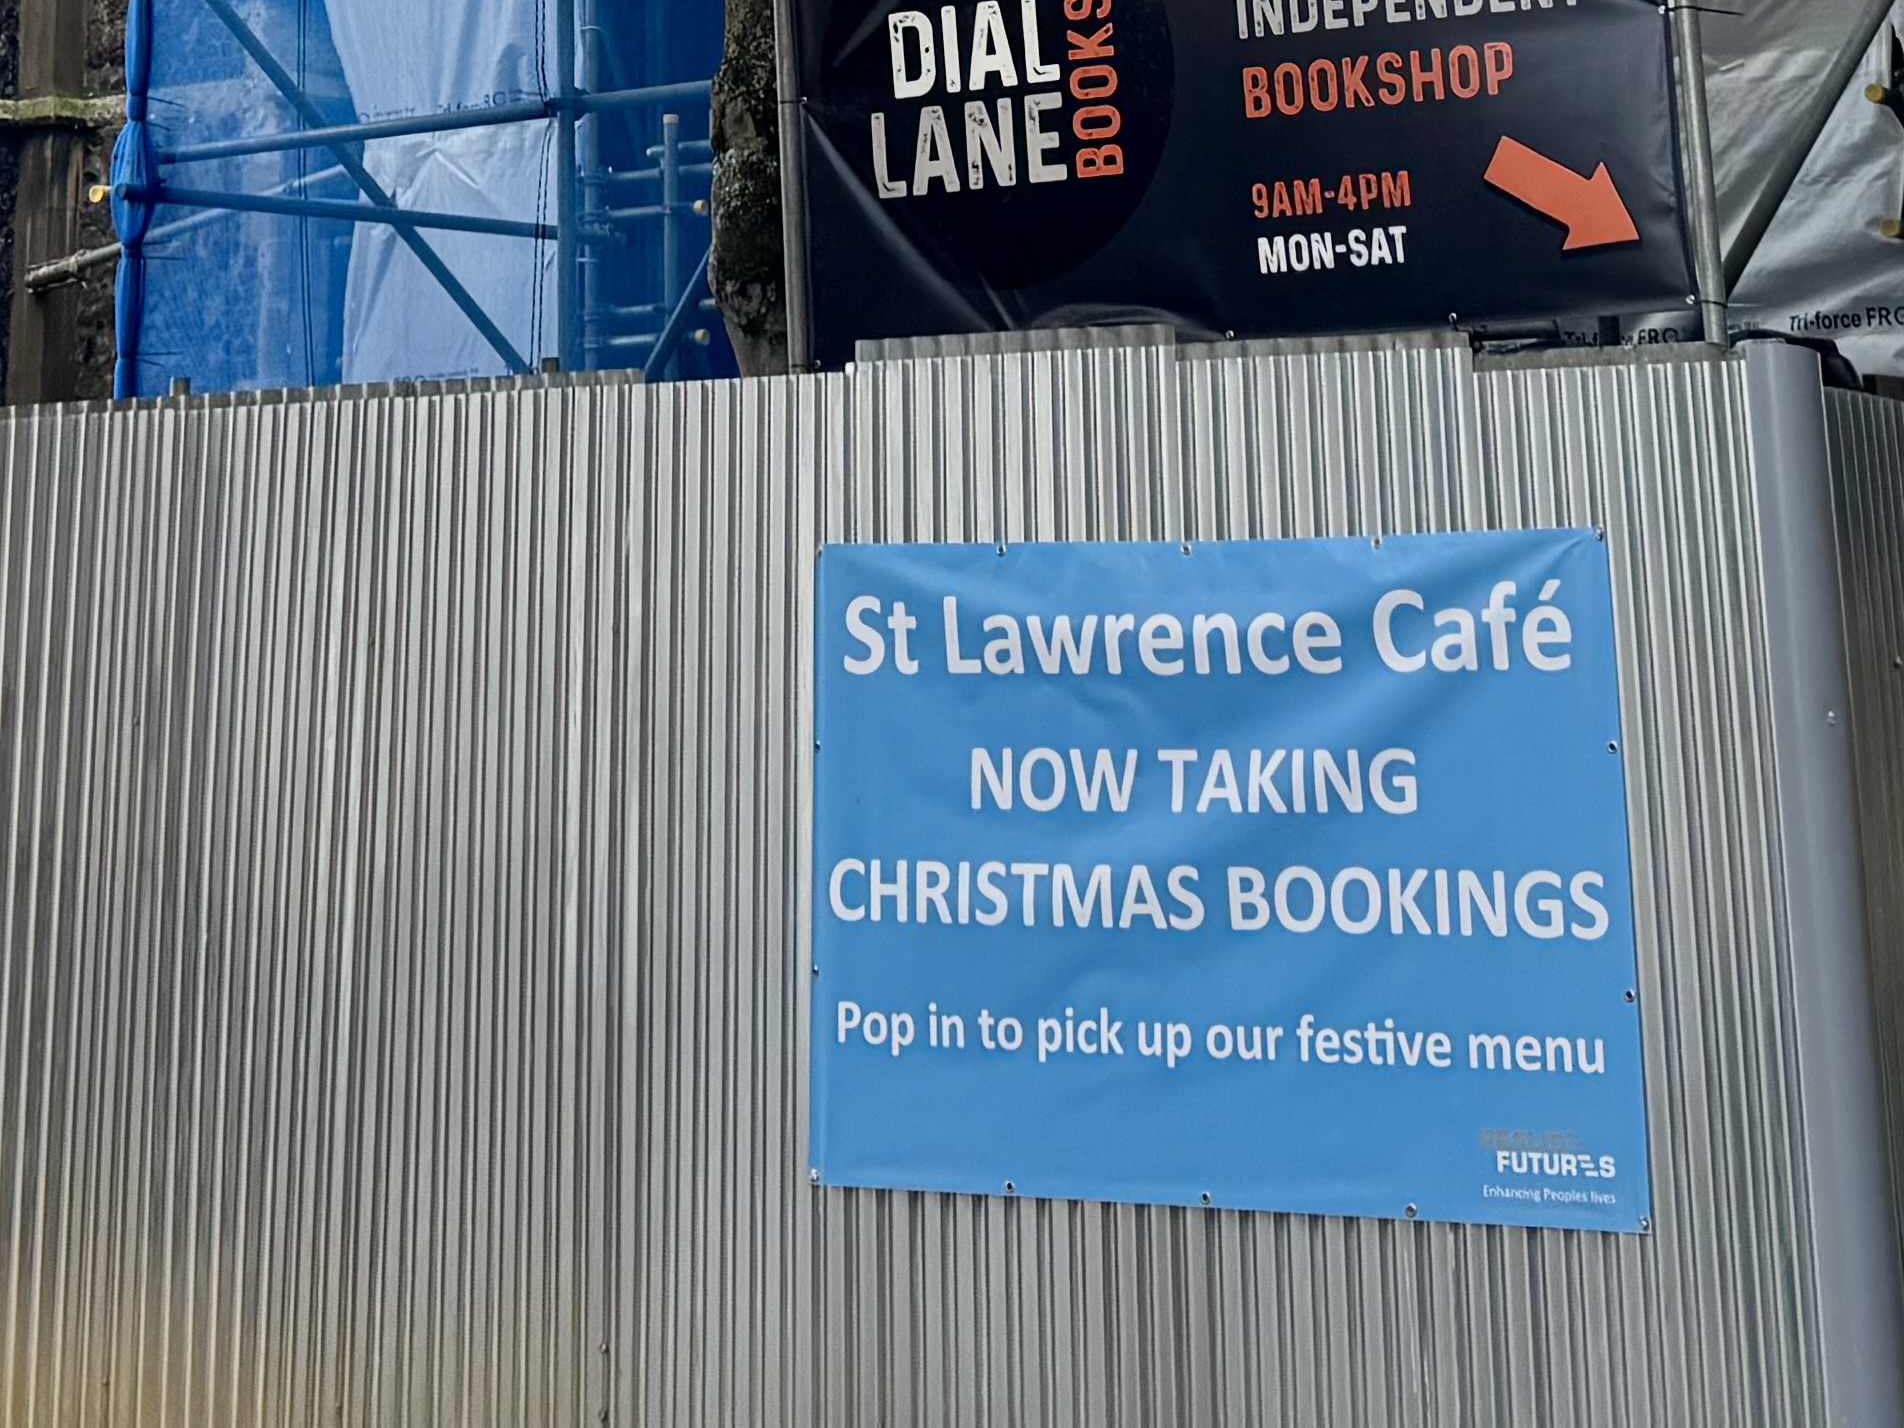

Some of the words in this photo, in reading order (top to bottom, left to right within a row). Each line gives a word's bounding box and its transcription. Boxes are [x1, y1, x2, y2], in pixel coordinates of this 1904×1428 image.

[1242, 41, 1516, 119] BOOKSHOP
[871, 91, 1069, 200] LANE
[1252, 170, 1412, 219] 9AM-4PM
[1257, 225, 1408, 275] MON-SAT
[1789, 311, 1861, 331] Tri-force
[1865, 307, 1892, 327] FR
[843, 595, 918, 676] St
[944, 595, 1343, 676] Lawrence
[1373, 579, 1573, 674] Café
[970, 748, 1137, 812] NOW
[1158, 748, 1418, 815] TAKING
[828, 857, 1205, 931] CHRISTMAS
[1227, 867, 1609, 940] BOOKINGS
[836, 1001, 915, 1056] Pop
[929, 1003, 965, 1050] in
[979, 1010, 1024, 1051] to
[1037, 1007, 1124, 1062] pick
[1136, 1020, 1192, 1068] up
[1205, 1024, 1284, 1061] our
[1296, 1014, 1452, 1067] festive
[1468, 1033, 1606, 1073] menu
[1483, 1184, 1541, 1203] Enhancing
[1543, 1188, 1588, 1204] Peoples
[1590, 1191, 1616, 1204] lives
[1496, 1150, 1617, 1178] FUTURES
